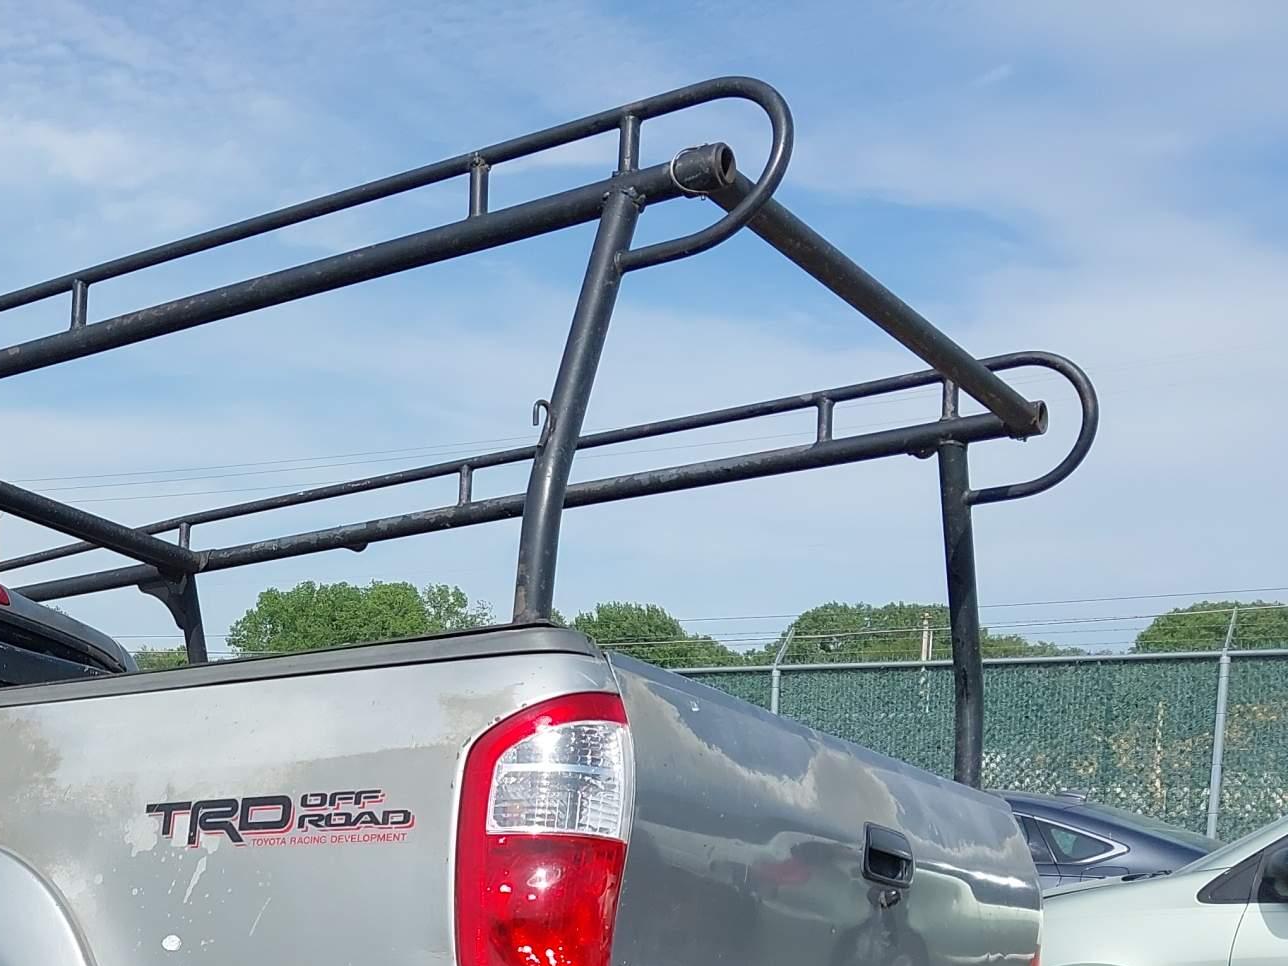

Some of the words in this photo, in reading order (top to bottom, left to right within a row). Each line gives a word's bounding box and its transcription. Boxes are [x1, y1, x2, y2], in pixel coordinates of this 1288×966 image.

[299, 789, 385, 810] OFF
[146, 795, 295, 848] TRD
[297, 809, 415, 832] ROAD
[251, 837, 286, 847] TOYOTA
[289, 835, 327, 846] RACING
[330, 833, 408, 843] DEVELOPMENT
